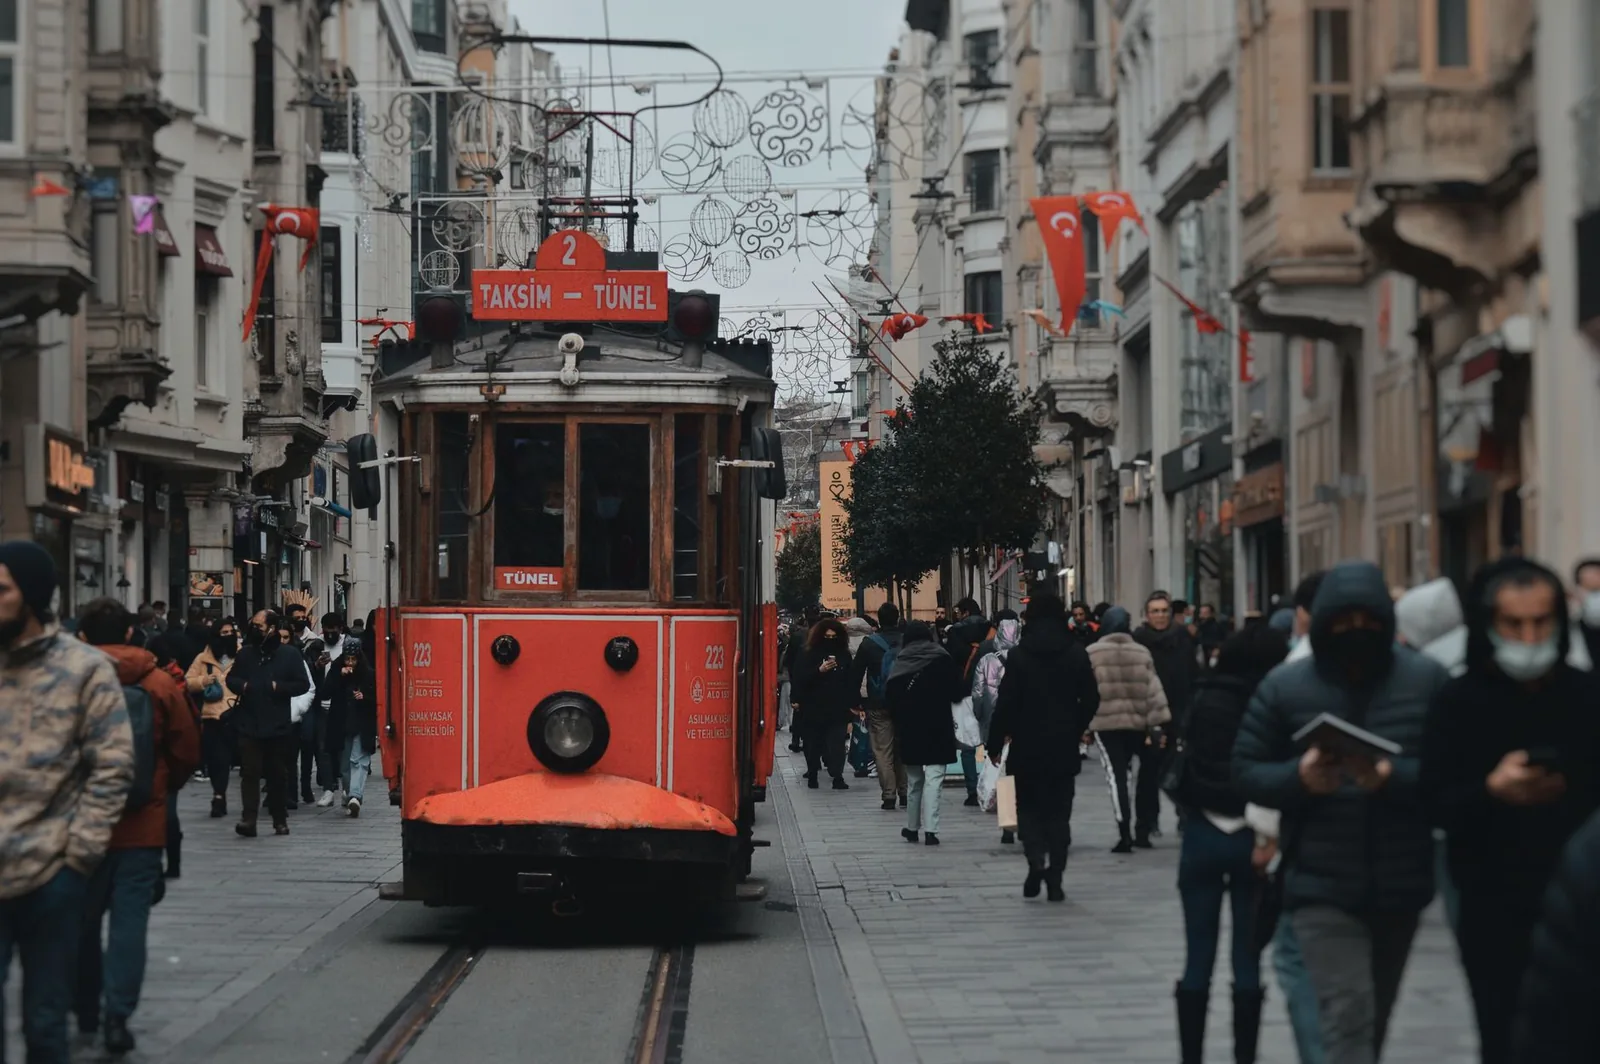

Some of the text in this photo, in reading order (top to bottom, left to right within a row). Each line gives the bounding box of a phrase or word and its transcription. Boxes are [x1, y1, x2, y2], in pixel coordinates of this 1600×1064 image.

[562, 234, 577, 266] 2
[479, 277, 552, 310] TAKSİM
[593, 277, 657, 310] TÜNEL
[503, 570, 558, 586] TÜNEL
[413, 642, 432, 668] 223
[705, 644, 724, 670] 223
[415, 688, 443, 698] ALO 153
[706, 690, 721, 700] ALO
[429, 711, 453, 722] YASAK
[686, 728, 696, 740] VE
